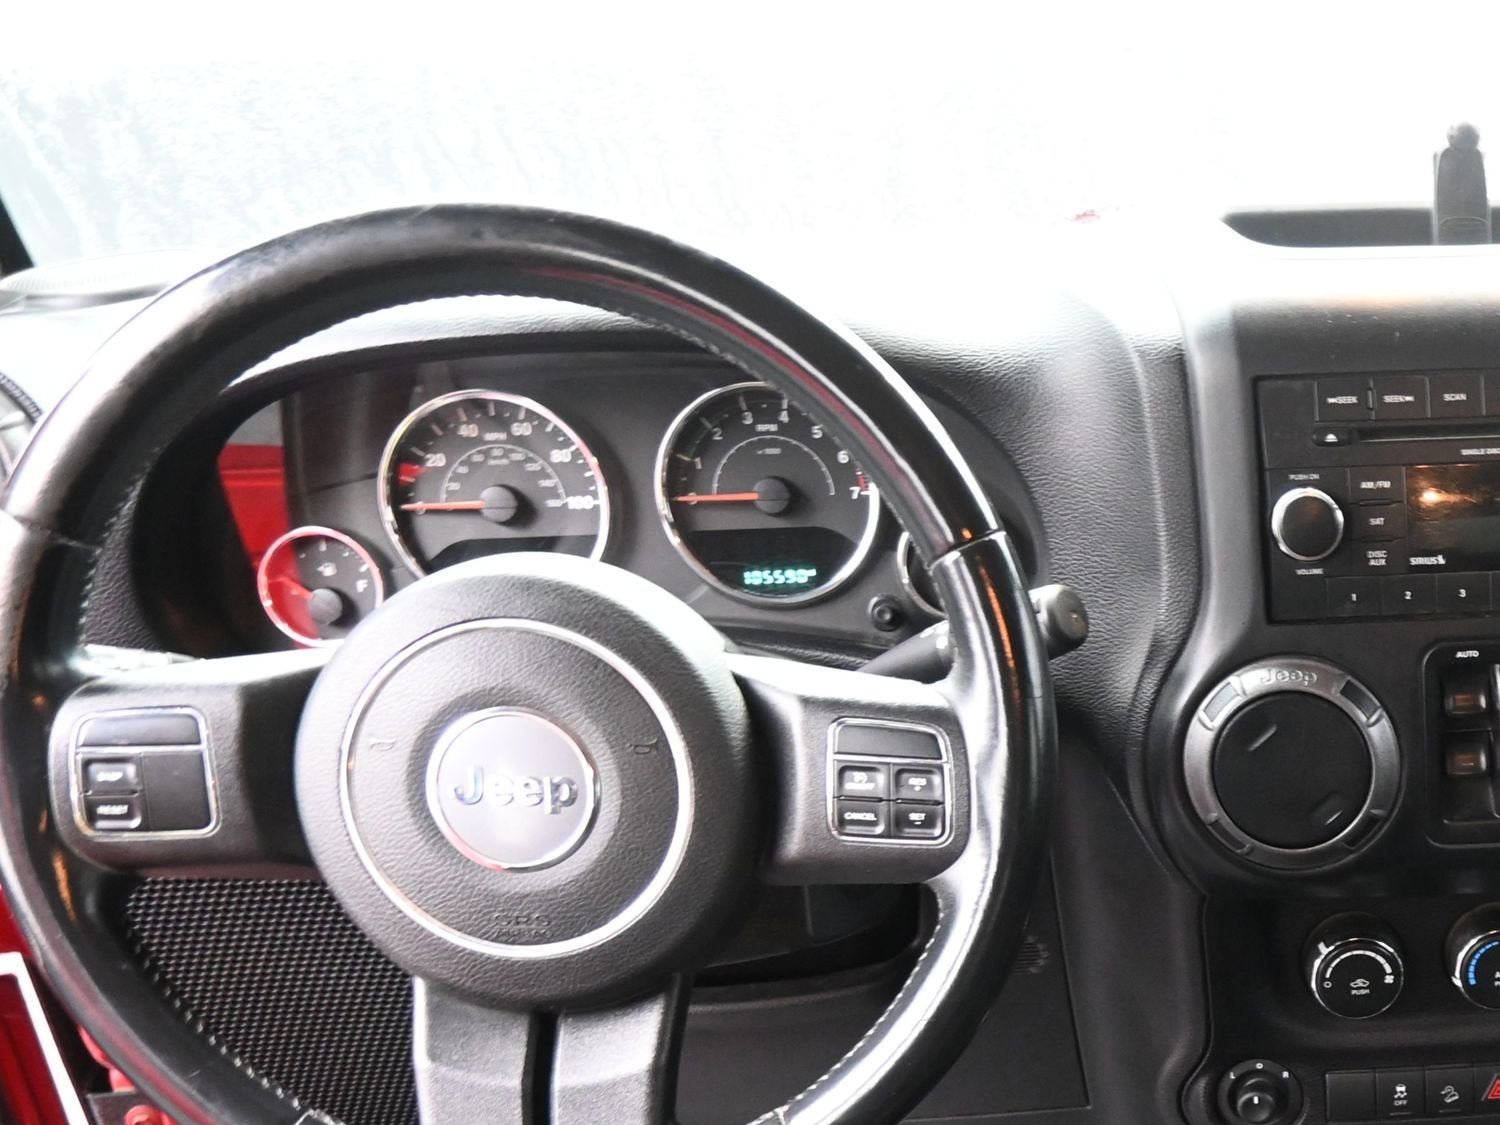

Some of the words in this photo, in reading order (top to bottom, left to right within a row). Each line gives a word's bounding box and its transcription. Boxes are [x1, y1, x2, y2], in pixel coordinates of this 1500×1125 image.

[1336, 396, 1358, 404] SEEK
[1383, 395, 1405, 403] SEEK
[1443, 393, 1467, 401] SCAN
[741, 411, 753, 424] 3
[777, 411, 789, 423] 4
[457, 423, 479, 438] 40
[510, 422, 532, 437] 60
[755, 424, 778, 432] RPM
[811, 424, 823, 439] 5
[483, 432, 508, 442] MPH
[712, 427, 723, 440] 2
[424, 453, 446, 467] 20
[550, 449, 572, 463] 80
[837, 450, 849, 463] 6
[694, 456, 702, 469] 1
[1360, 481, 1391, 489] AM/FM
[849, 486, 861, 499] 7
[567, 495, 594, 510] 100
[1369, 517, 1385, 526] SAT
[1366, 550, 1388, 558] DISC
[1368, 558, 1387, 566] AUX
[1409, 556, 1438, 566] SIRIUS
[356, 579, 368, 593] F
[1350, 593, 1357, 601] 1
[1404, 591, 1412, 600] 2
[1458, 588, 1467, 598] 3
[1455, 650, 1479, 658] AUTO
[1259, 667, 1317, 686] Jeep
[454, 764, 579, 815] Jeep
[1351, 988, 1370, 996] PUSH
[1229, 1071, 1236, 1080] L
[1282, 1070, 1289, 1079] R
